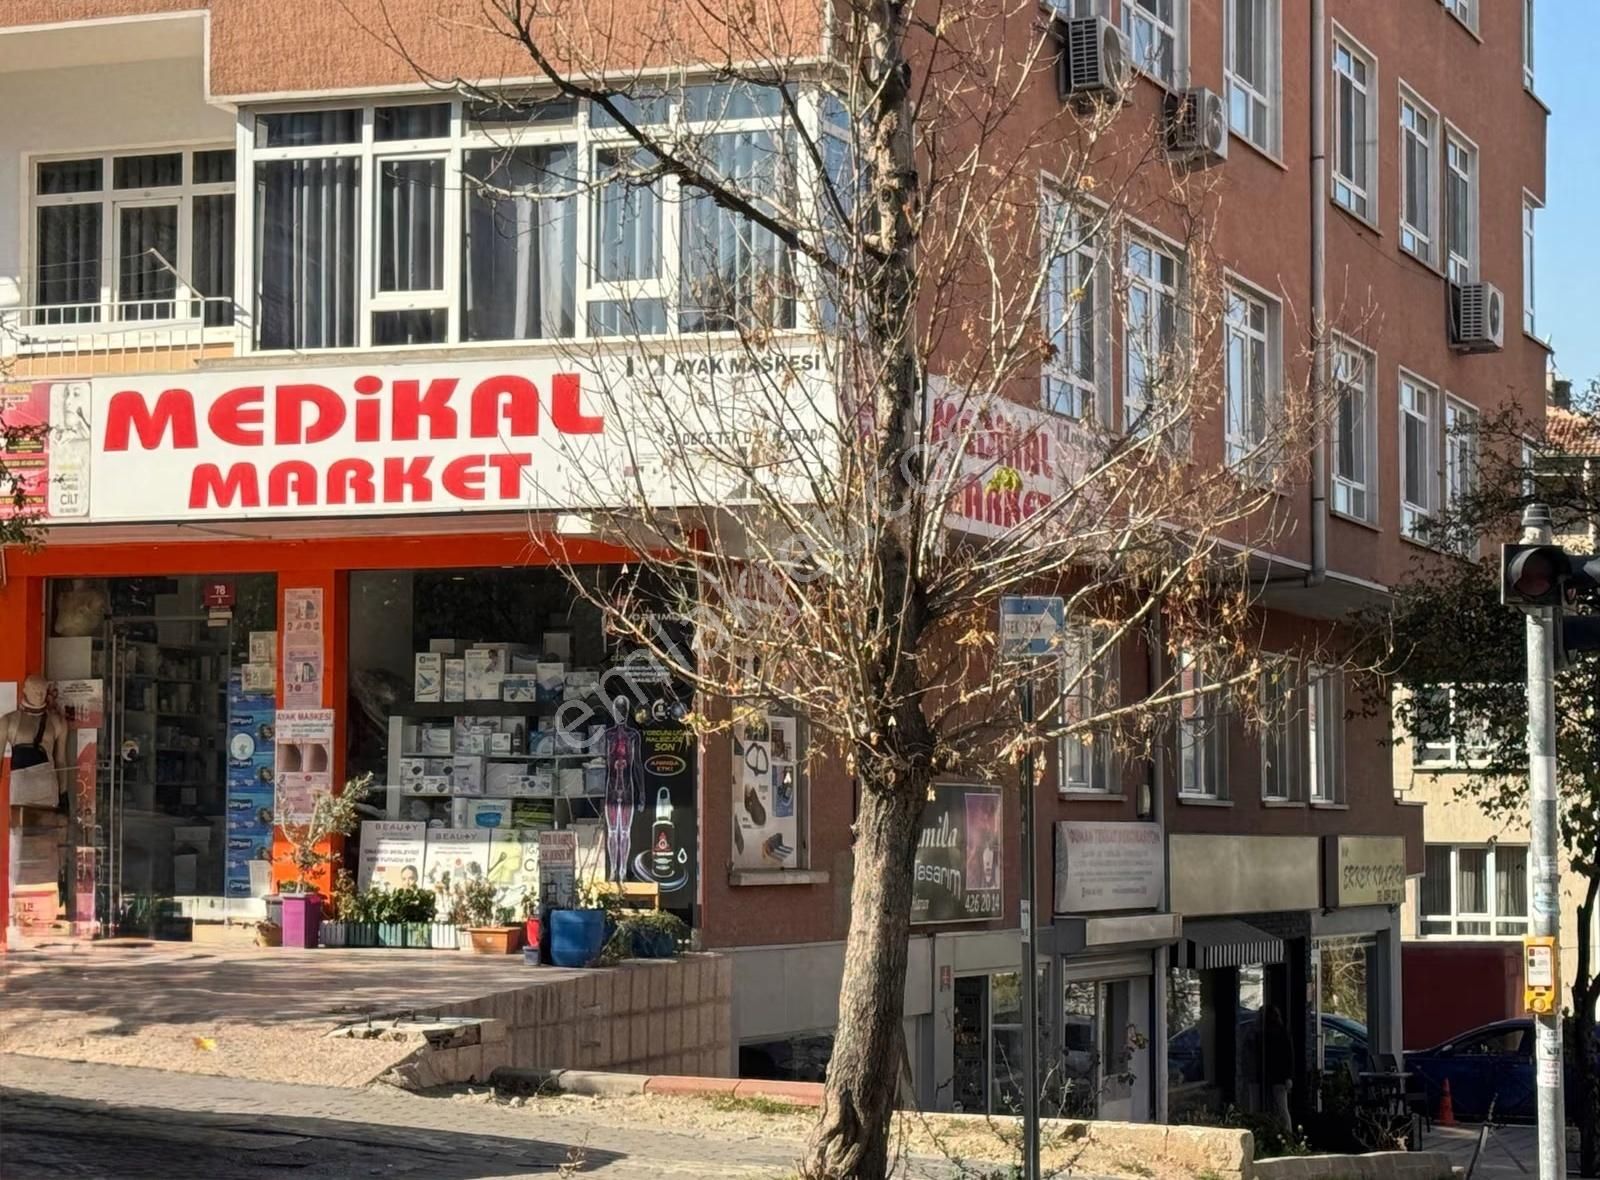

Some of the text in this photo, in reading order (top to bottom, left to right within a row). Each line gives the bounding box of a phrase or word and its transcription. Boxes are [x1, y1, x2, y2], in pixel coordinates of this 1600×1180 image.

[673, 358, 724, 377] AYAK
[730, 351, 820, 375] MASKESİ
[188, 452, 533, 509] MARKET
[214, 584, 226, 595] 78
[654, 743, 675, 751] SON
[917, 811, 958, 849] mila
[981, 893, 991, 912] 20
